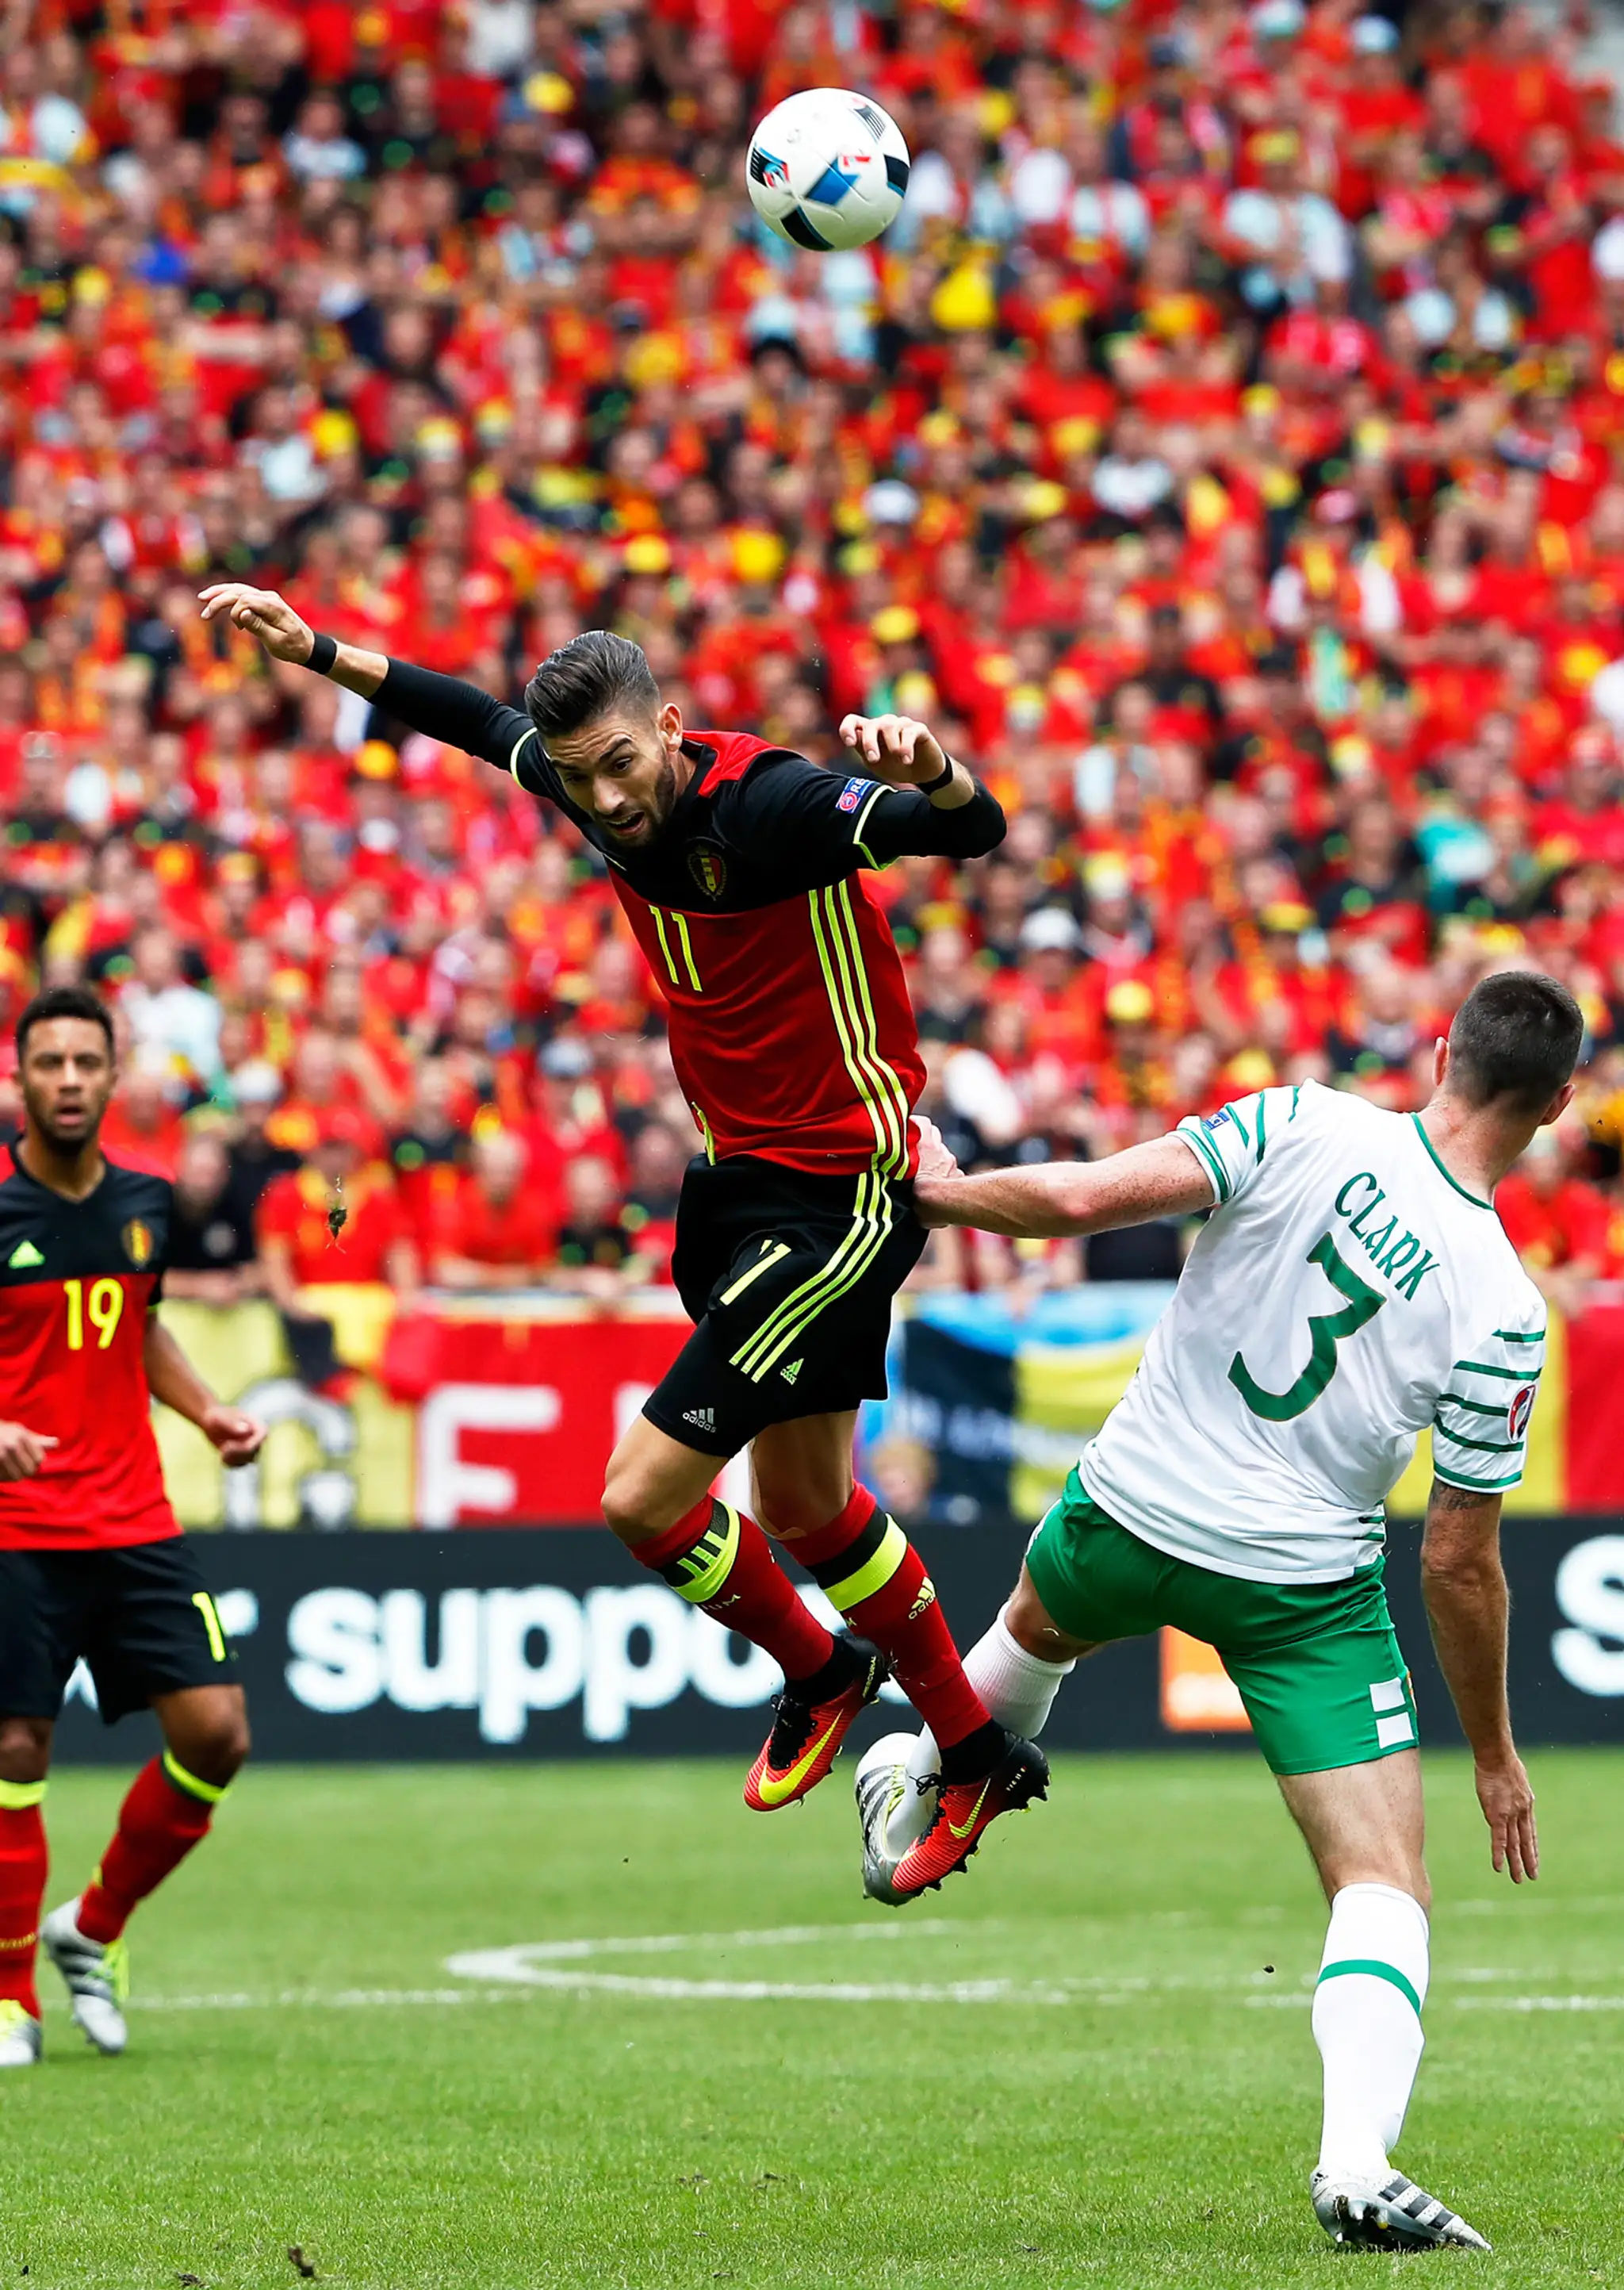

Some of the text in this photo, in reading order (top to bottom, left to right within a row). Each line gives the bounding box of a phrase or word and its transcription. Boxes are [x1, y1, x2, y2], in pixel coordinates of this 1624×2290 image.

[649, 904, 702, 992] 11
[1334, 1171, 1440, 1302] CLARK
[63, 1276, 124, 1350] 19
[1228, 1231, 1387, 1422] 3
[682, 1412, 717, 1433] adidas
[284, 1586, 912, 1743] suppo
